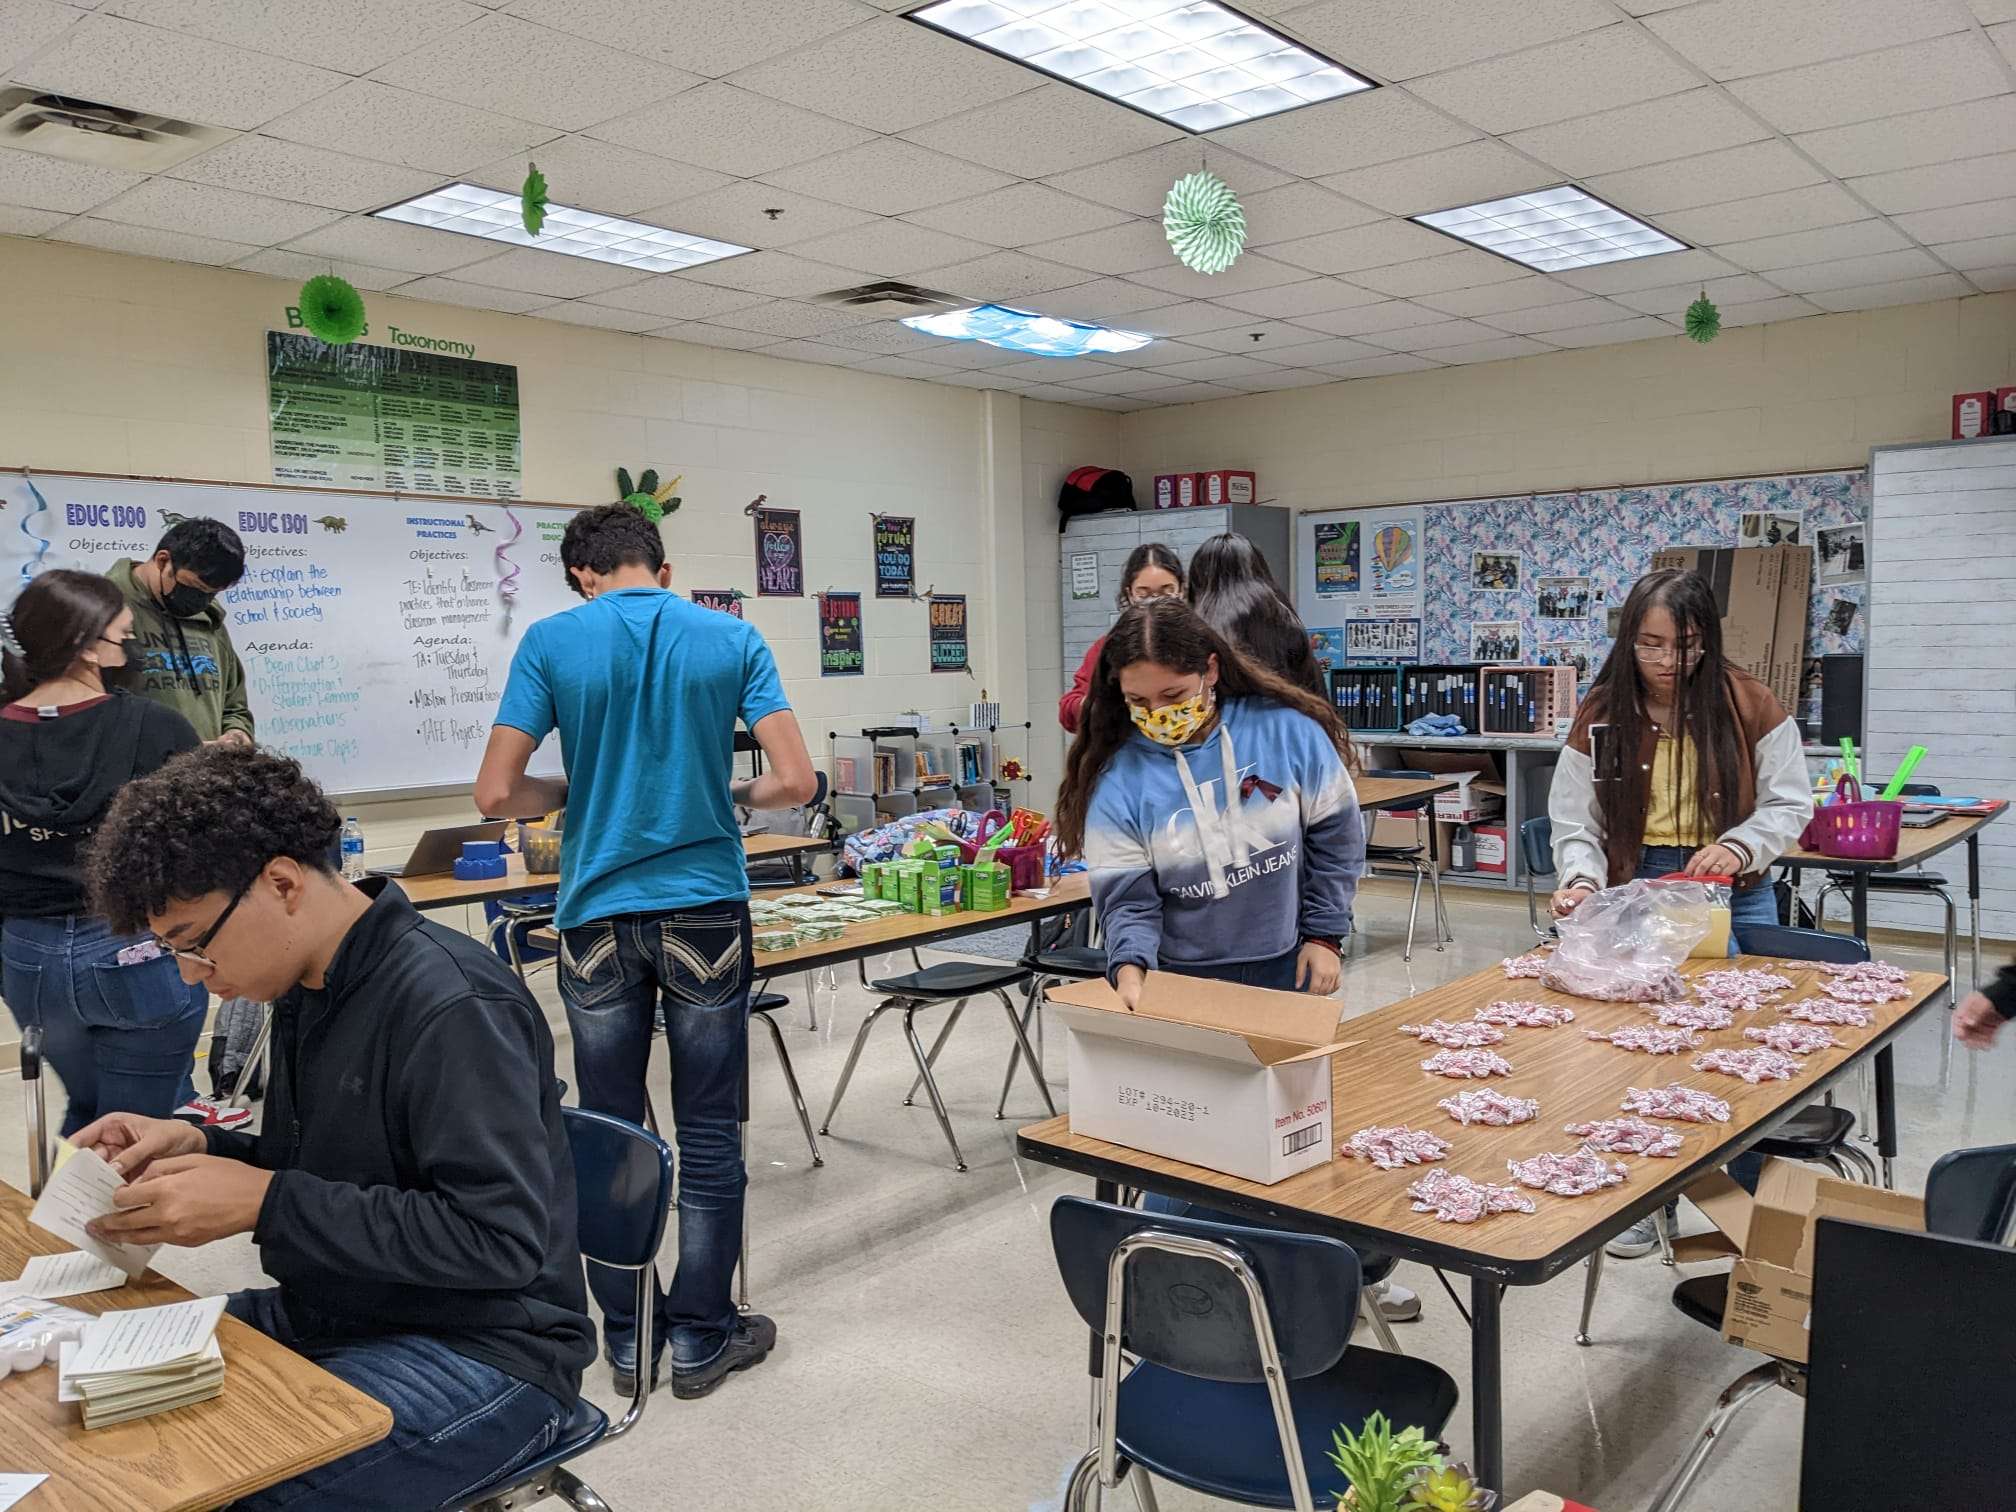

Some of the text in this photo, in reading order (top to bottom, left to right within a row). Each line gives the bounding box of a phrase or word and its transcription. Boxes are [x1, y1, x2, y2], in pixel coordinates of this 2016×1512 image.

[388, 325, 475, 358] Taxonomy
[66, 503, 147, 528] EDUC 1300
[239, 511, 308, 534] EDUC 1301
[406, 517, 465, 527] INSTRUCTIONAL
[416, 530, 457, 539] PRACTICES
[69, 538, 149, 553] Objectives:
[409, 549, 470, 562] Objectives:
[878, 553, 896, 564] YOU
[260, 564, 304, 583] explain
[307, 563, 328, 579] the
[761, 566, 798, 590] HEART
[879, 565, 909, 576] TODAY
[225, 583, 342, 603] relationship between
[234, 607, 269, 625] school
[282, 602, 324, 622] society
[441, 608, 493, 629] management
[245, 638, 314, 655] Agenda:
[413, 634, 473, 648] Agenda:
[431, 647, 471, 669] Tuesday
[823, 651, 863, 669] inspire
[443, 664, 488, 688] Thursday
[1225, 864, 1262, 888] KLEIN
[1274, 1114, 1291, 1130] Item
[1292, 1109, 1306, 1122] No.
